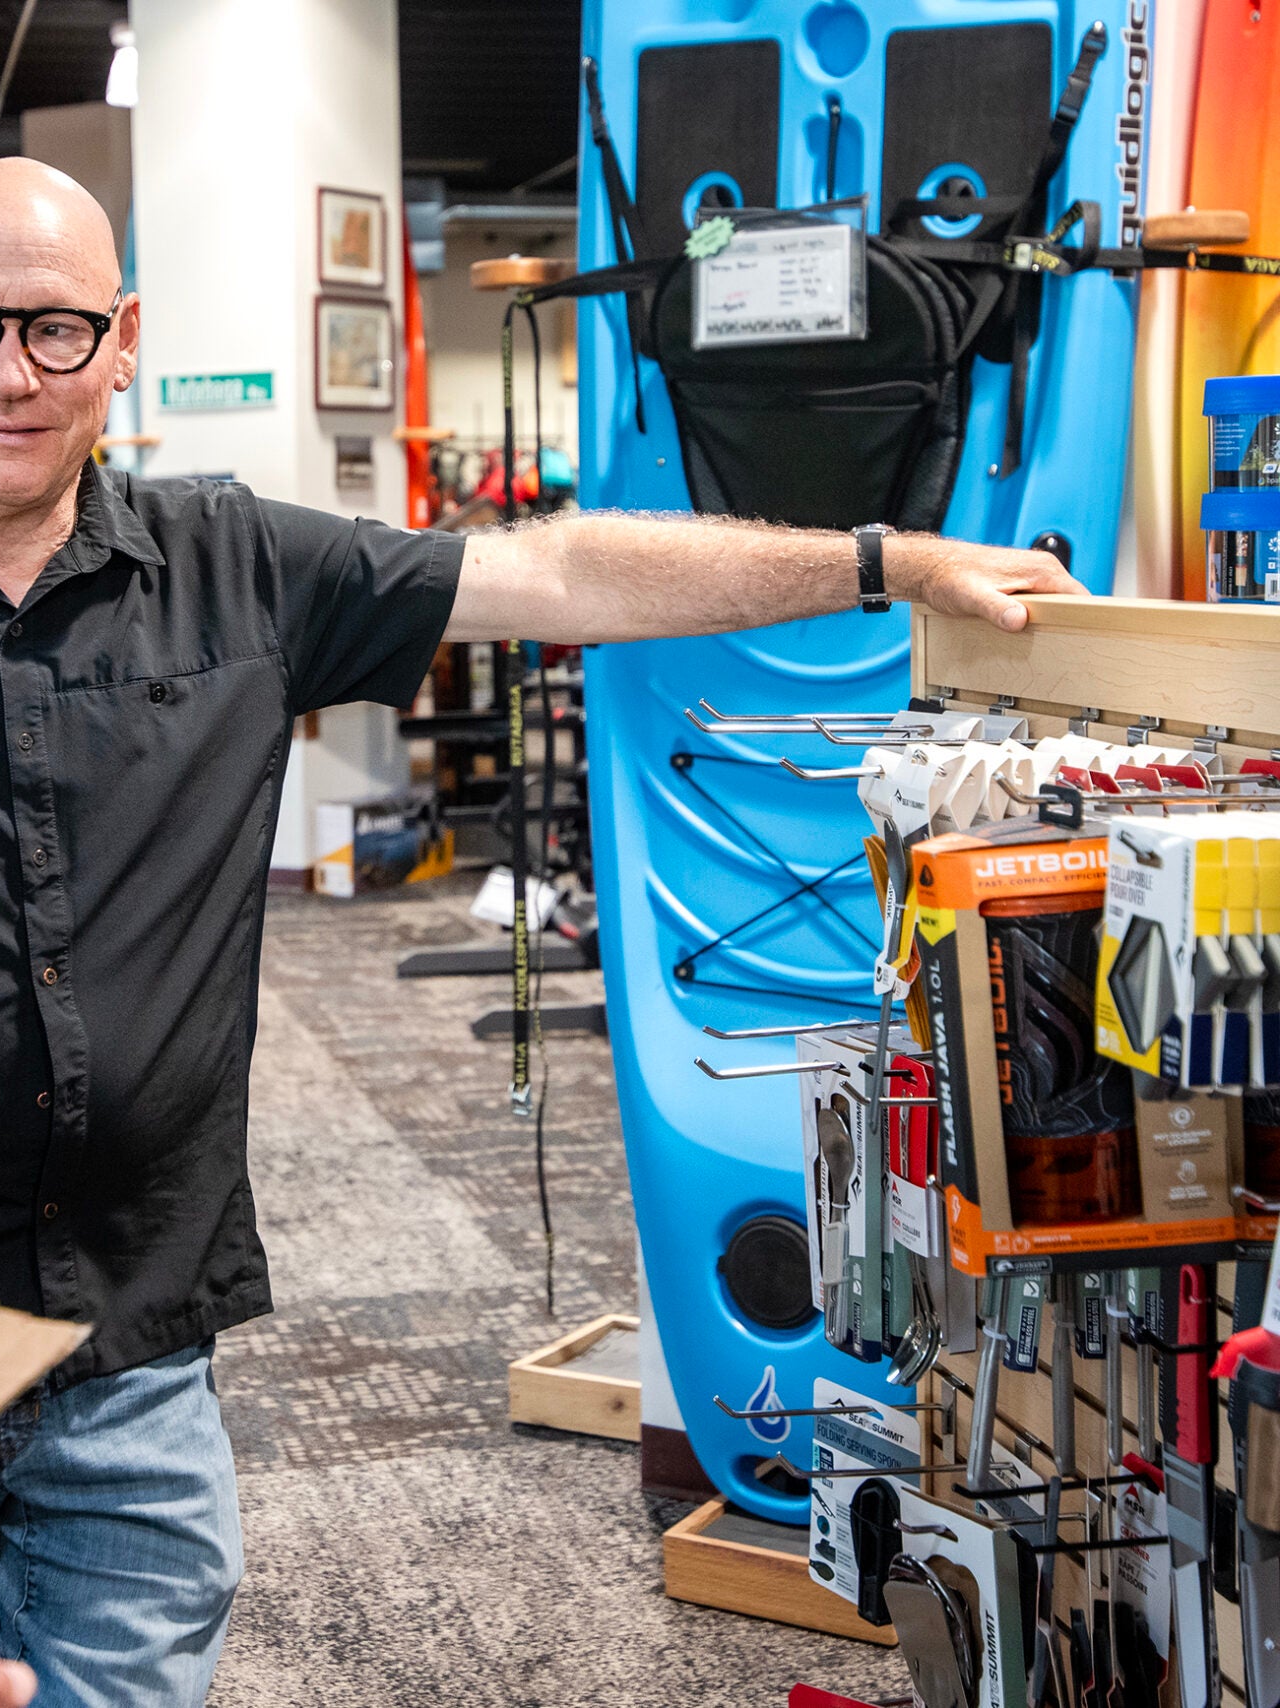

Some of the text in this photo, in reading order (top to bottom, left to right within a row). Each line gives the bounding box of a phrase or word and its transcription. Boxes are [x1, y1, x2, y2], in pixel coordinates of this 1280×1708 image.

[1114, 0, 1149, 279] quidlogic
[975, 849, 1109, 878] JETBOIL
[1064, 872, 1108, 883] EFFICIEN
[1110, 864, 1153, 891] COLLAPSIBLE
[988, 942, 1013, 1105] JETBOIL
[929, 958, 958, 1166] FLASH JAVA 1.0L
[816, 1424, 846, 1447] FOLDING
[846, 1437, 877, 1461] SERVING
[848, 1412, 864, 1426] SEA
[871, 1423, 904, 1444] SUMMIT
[1123, 1497, 1145, 1517] MSR
[985, 1609, 999, 1682] SUMMIT
